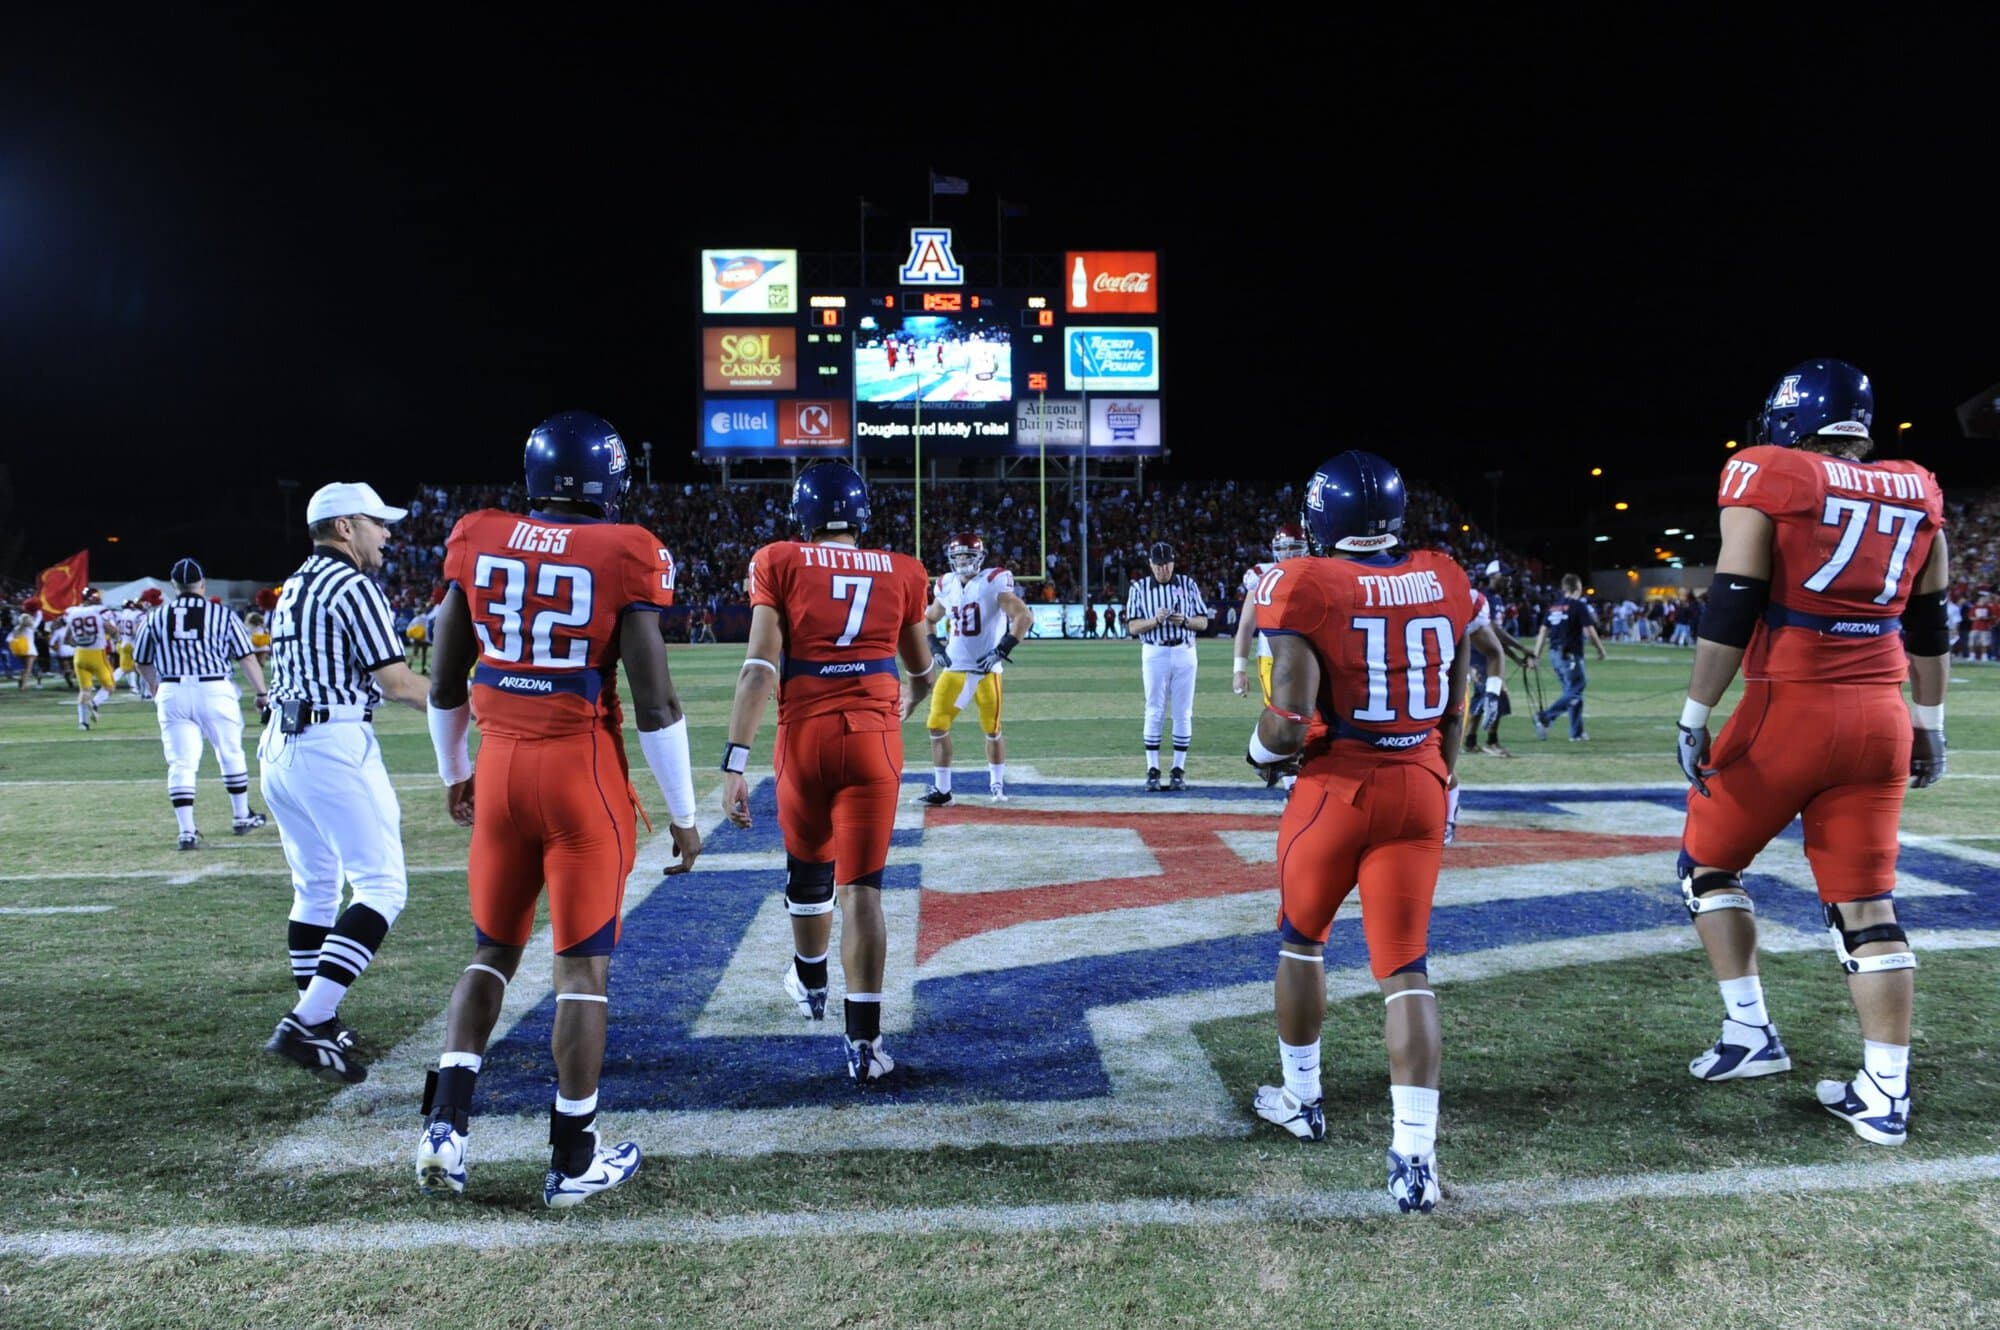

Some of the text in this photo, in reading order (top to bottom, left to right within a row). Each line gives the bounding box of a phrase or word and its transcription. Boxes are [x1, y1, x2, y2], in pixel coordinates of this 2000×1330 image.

[720, 334, 781, 363] SOL
[1091, 335, 1134, 349] Tucson
[1096, 348, 1146, 360] Electric
[720, 363, 782, 377] CASINOS
[1101, 360, 1146, 372] Power
[857, 422, 909, 438] Douglas
[938, 422, 971, 438] Molly
[1721, 460, 1758, 498] 77
[1821, 460, 1925, 500] BRITTON
[507, 521, 572, 554] NESS
[1803, 496, 1928, 605] 77
[800, 547, 893, 574] TUITAMA
[1357, 570, 1443, 607] THOMAS
[173, 607, 198, 639] L
[474, 554, 593, 668] 32
[831, 574, 874, 647] 7
[951, 602, 981, 637] 10
[72, 616, 98, 637] 89
[1830, 622, 1880, 635] ARIZONA
[820, 662, 866, 675] ARIZONA
[1352, 616, 1456, 722] 10
[499, 675, 552, 692] ARIZONA
